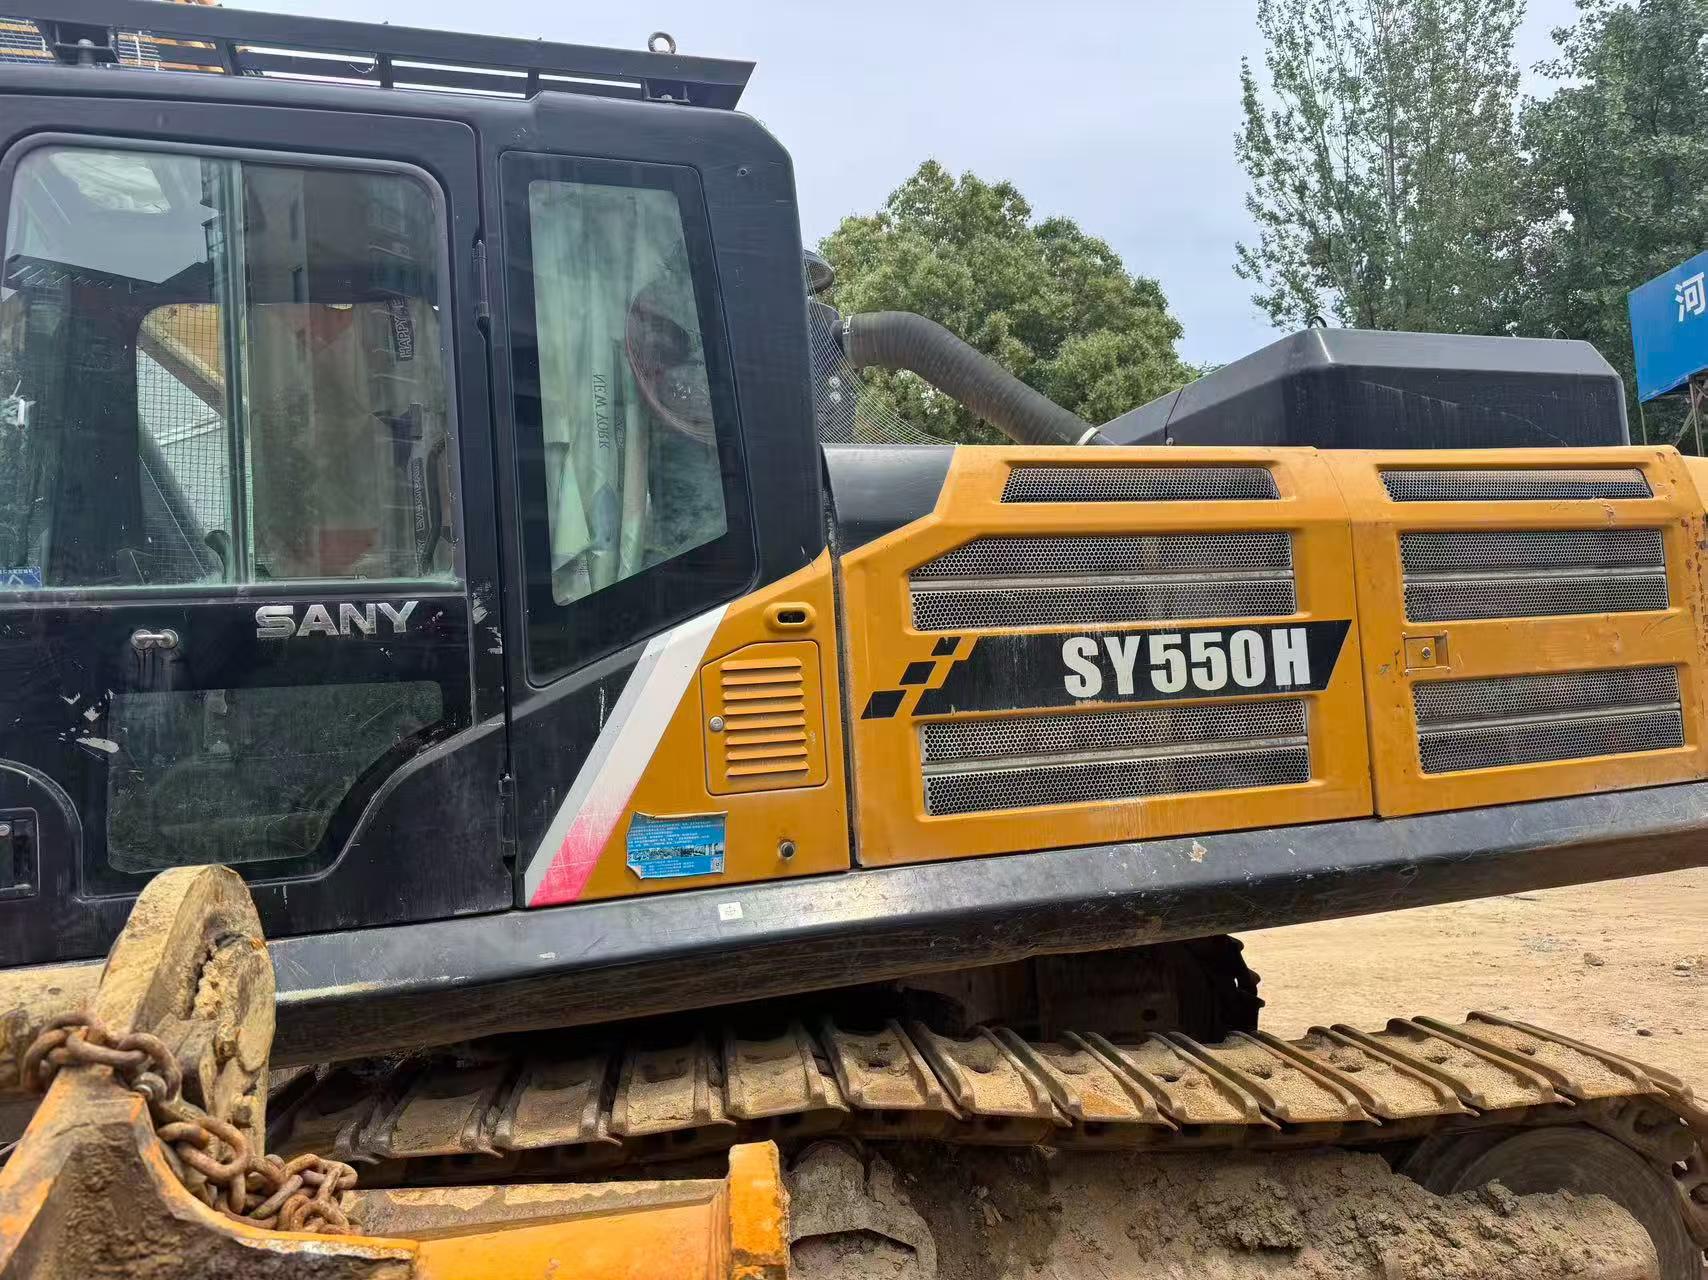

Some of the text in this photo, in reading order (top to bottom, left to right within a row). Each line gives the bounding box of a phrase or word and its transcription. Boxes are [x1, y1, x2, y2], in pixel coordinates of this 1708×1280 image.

[1675, 272, 1706, 322] 河
[395, 316, 412, 358] HAPPY
[255, 600, 419, 638] SANY
[1062, 627, 1311, 698] SY550H
